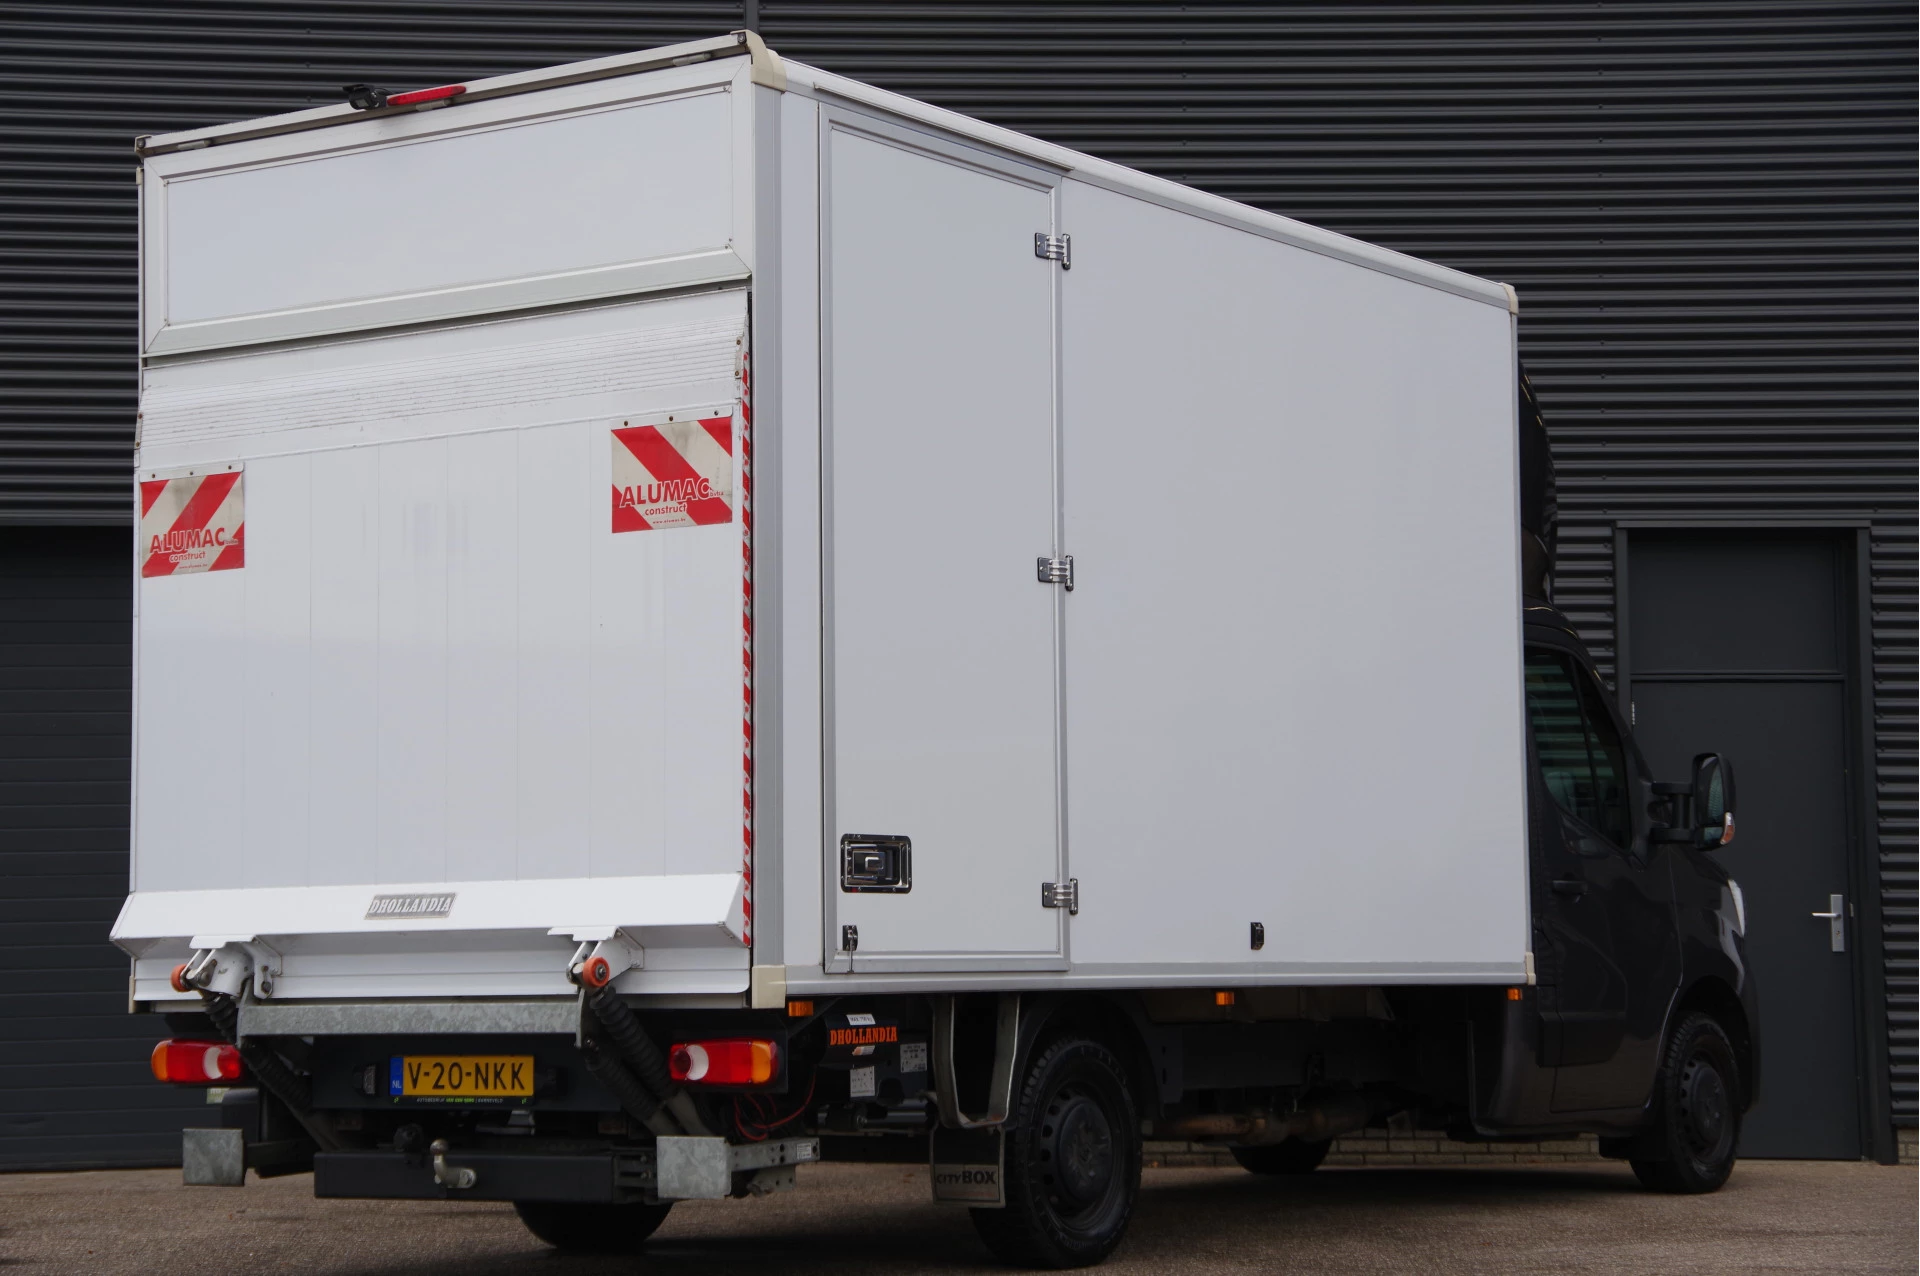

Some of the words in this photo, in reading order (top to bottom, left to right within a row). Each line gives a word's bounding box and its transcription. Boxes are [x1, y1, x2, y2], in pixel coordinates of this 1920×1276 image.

[620, 477, 711, 508] ALUMAC
[644, 503, 687, 516] construct
[149, 527, 225, 554] ALUMAC
[169, 551, 206, 563] construct
[368, 897, 453, 914] DHOLLANDIA
[829, 1026, 898, 1046] DHOLLANDIA
[391, 1079, 403, 1089] NL
[407, 1062, 526, 1091] V-20-NKK
